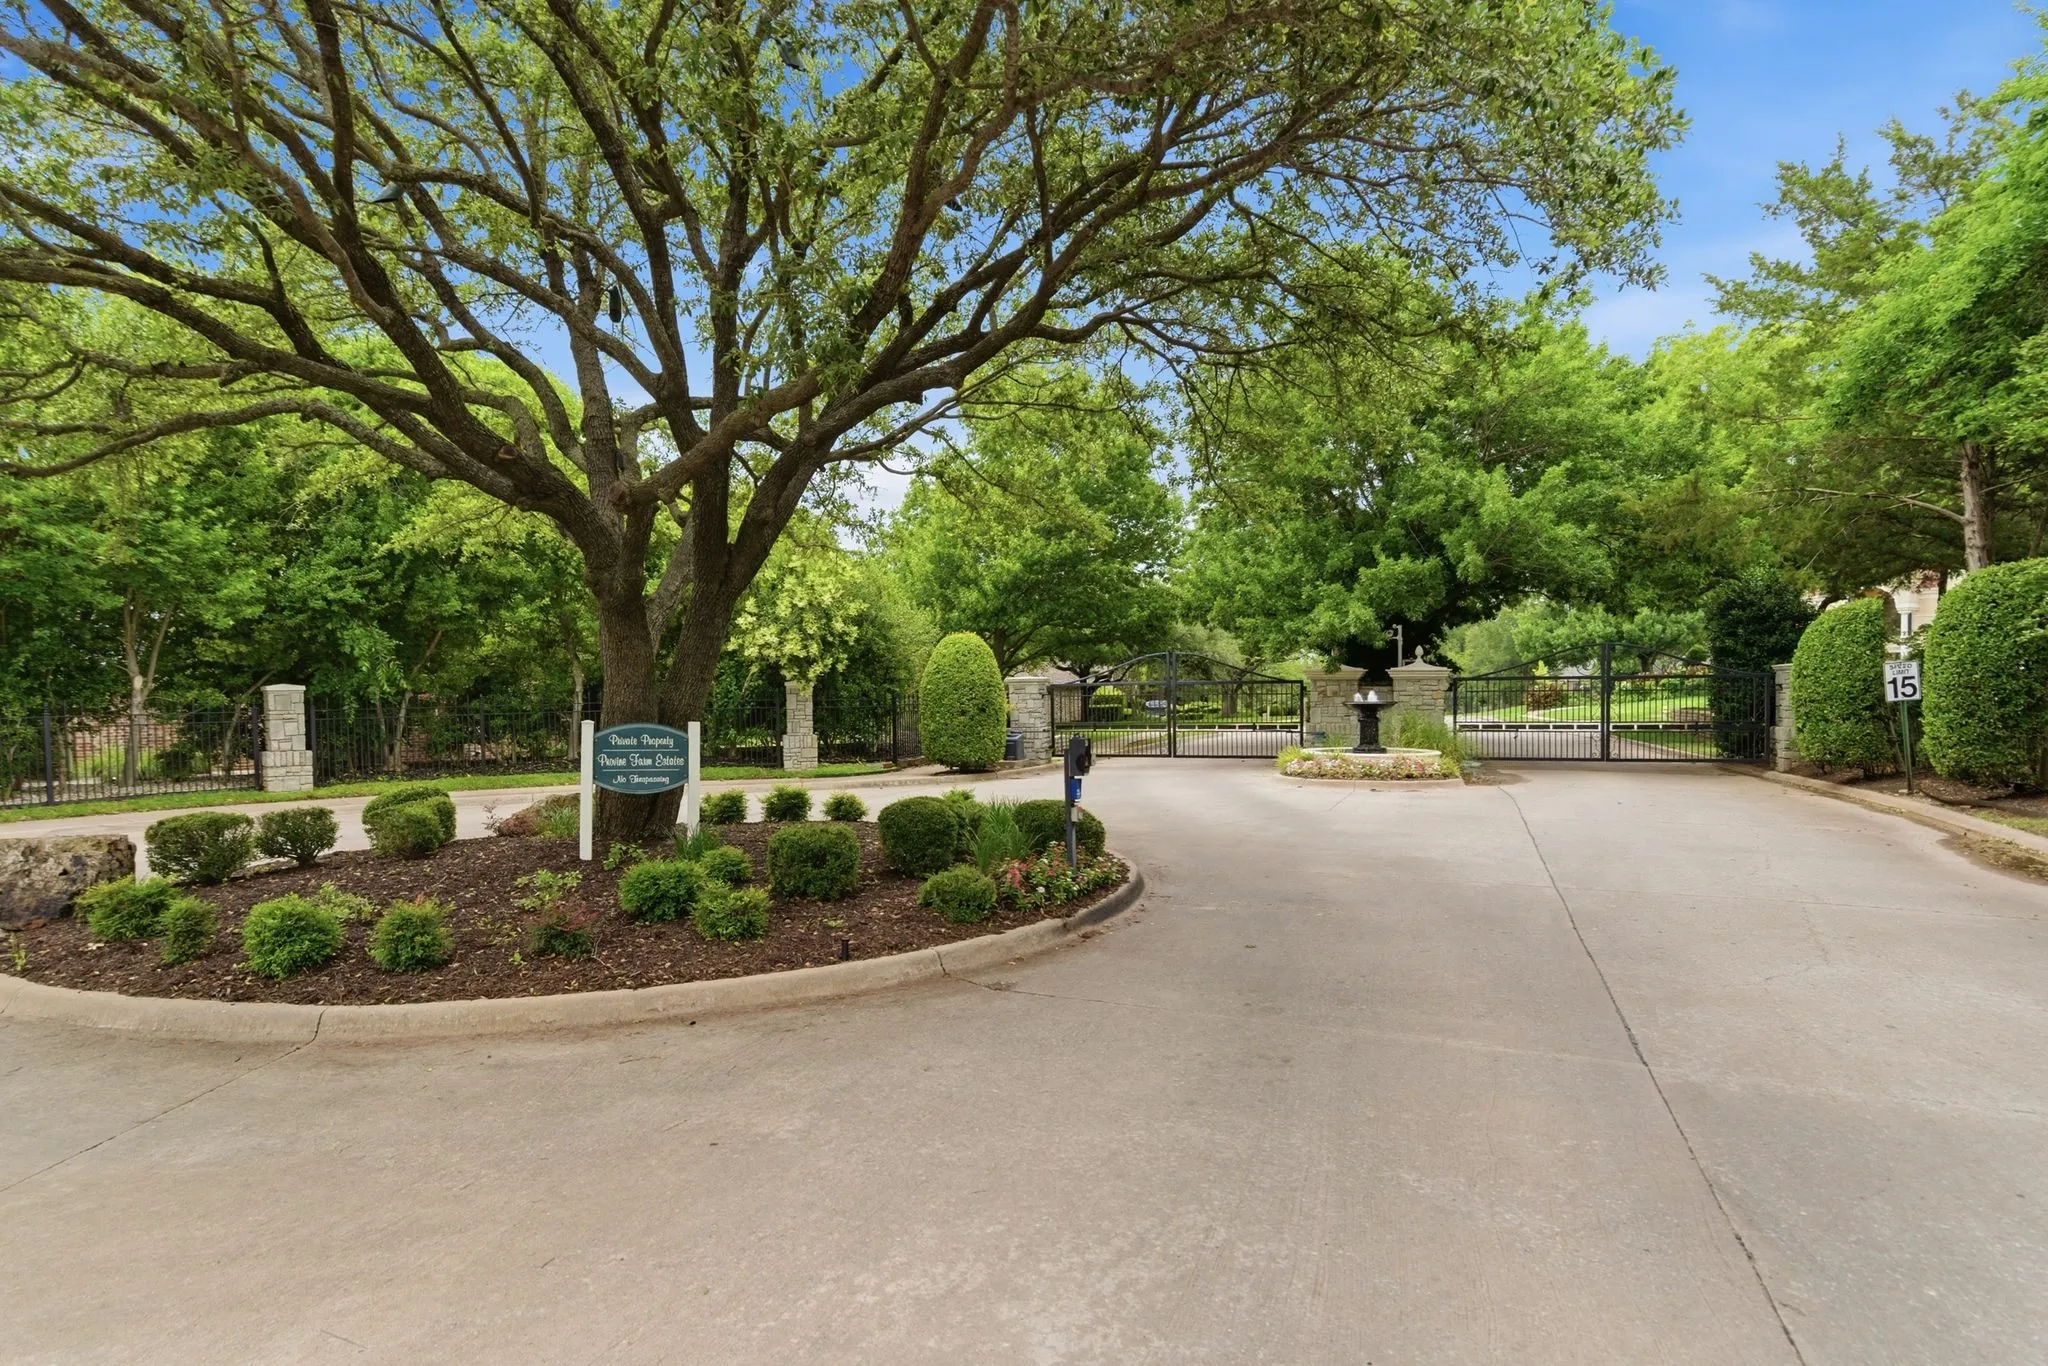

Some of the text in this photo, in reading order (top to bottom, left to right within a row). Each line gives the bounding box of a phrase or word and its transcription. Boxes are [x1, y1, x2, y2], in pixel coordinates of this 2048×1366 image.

[1887, 676, 1917, 698] 15
[609, 734, 674, 748] Private Property
[597, 754, 685, 766] Provine Farm Estates
[613, 775, 670, 784] No Trespassing
